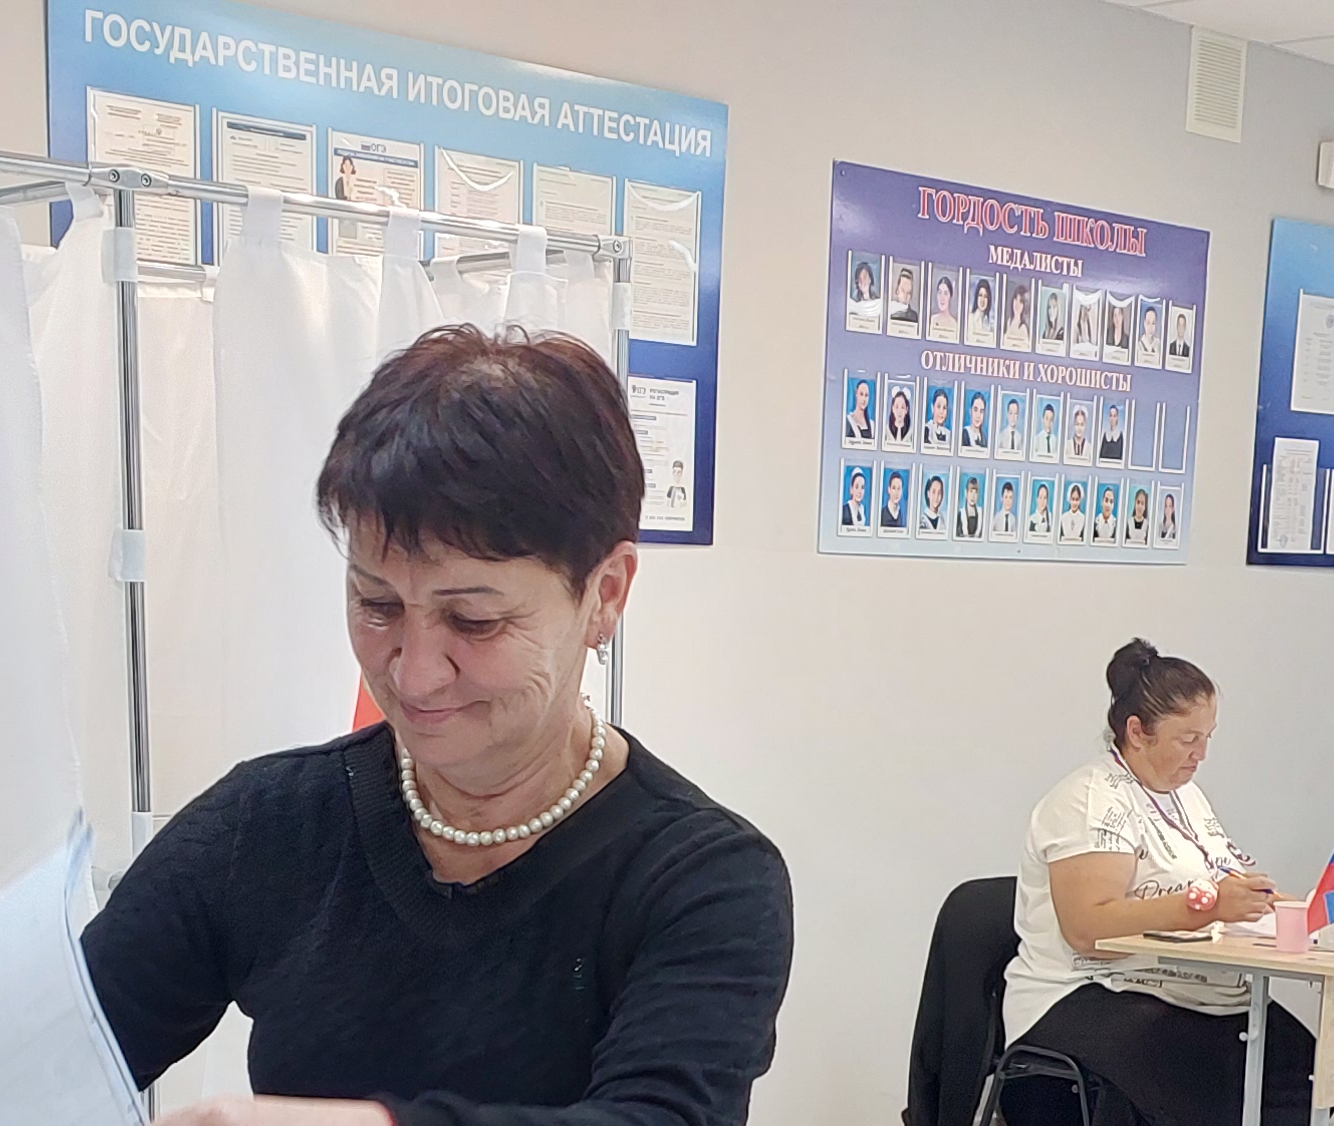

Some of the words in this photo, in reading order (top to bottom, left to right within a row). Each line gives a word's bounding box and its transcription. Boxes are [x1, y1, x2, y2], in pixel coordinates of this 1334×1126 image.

[83, 9, 399, 99] ГОСУДАРСТВЕННАЯ
[407, 70, 552, 127] ИТОГОВАЯ
[556, 101, 713, 158] АТТЕСТАЦИЯ
[919, 185, 1049, 240] ГОРДОСТЬ
[1053, 211, 1147, 257] ШКОЛЫ
[988, 244, 1084, 278] МЕДАЛИСТЫ
[920, 349, 1020, 380] ОТЛИЧНИКИ
[1022, 362, 1034, 380] И
[1037, 363, 1132, 391] ХОРОШИСТЫ
